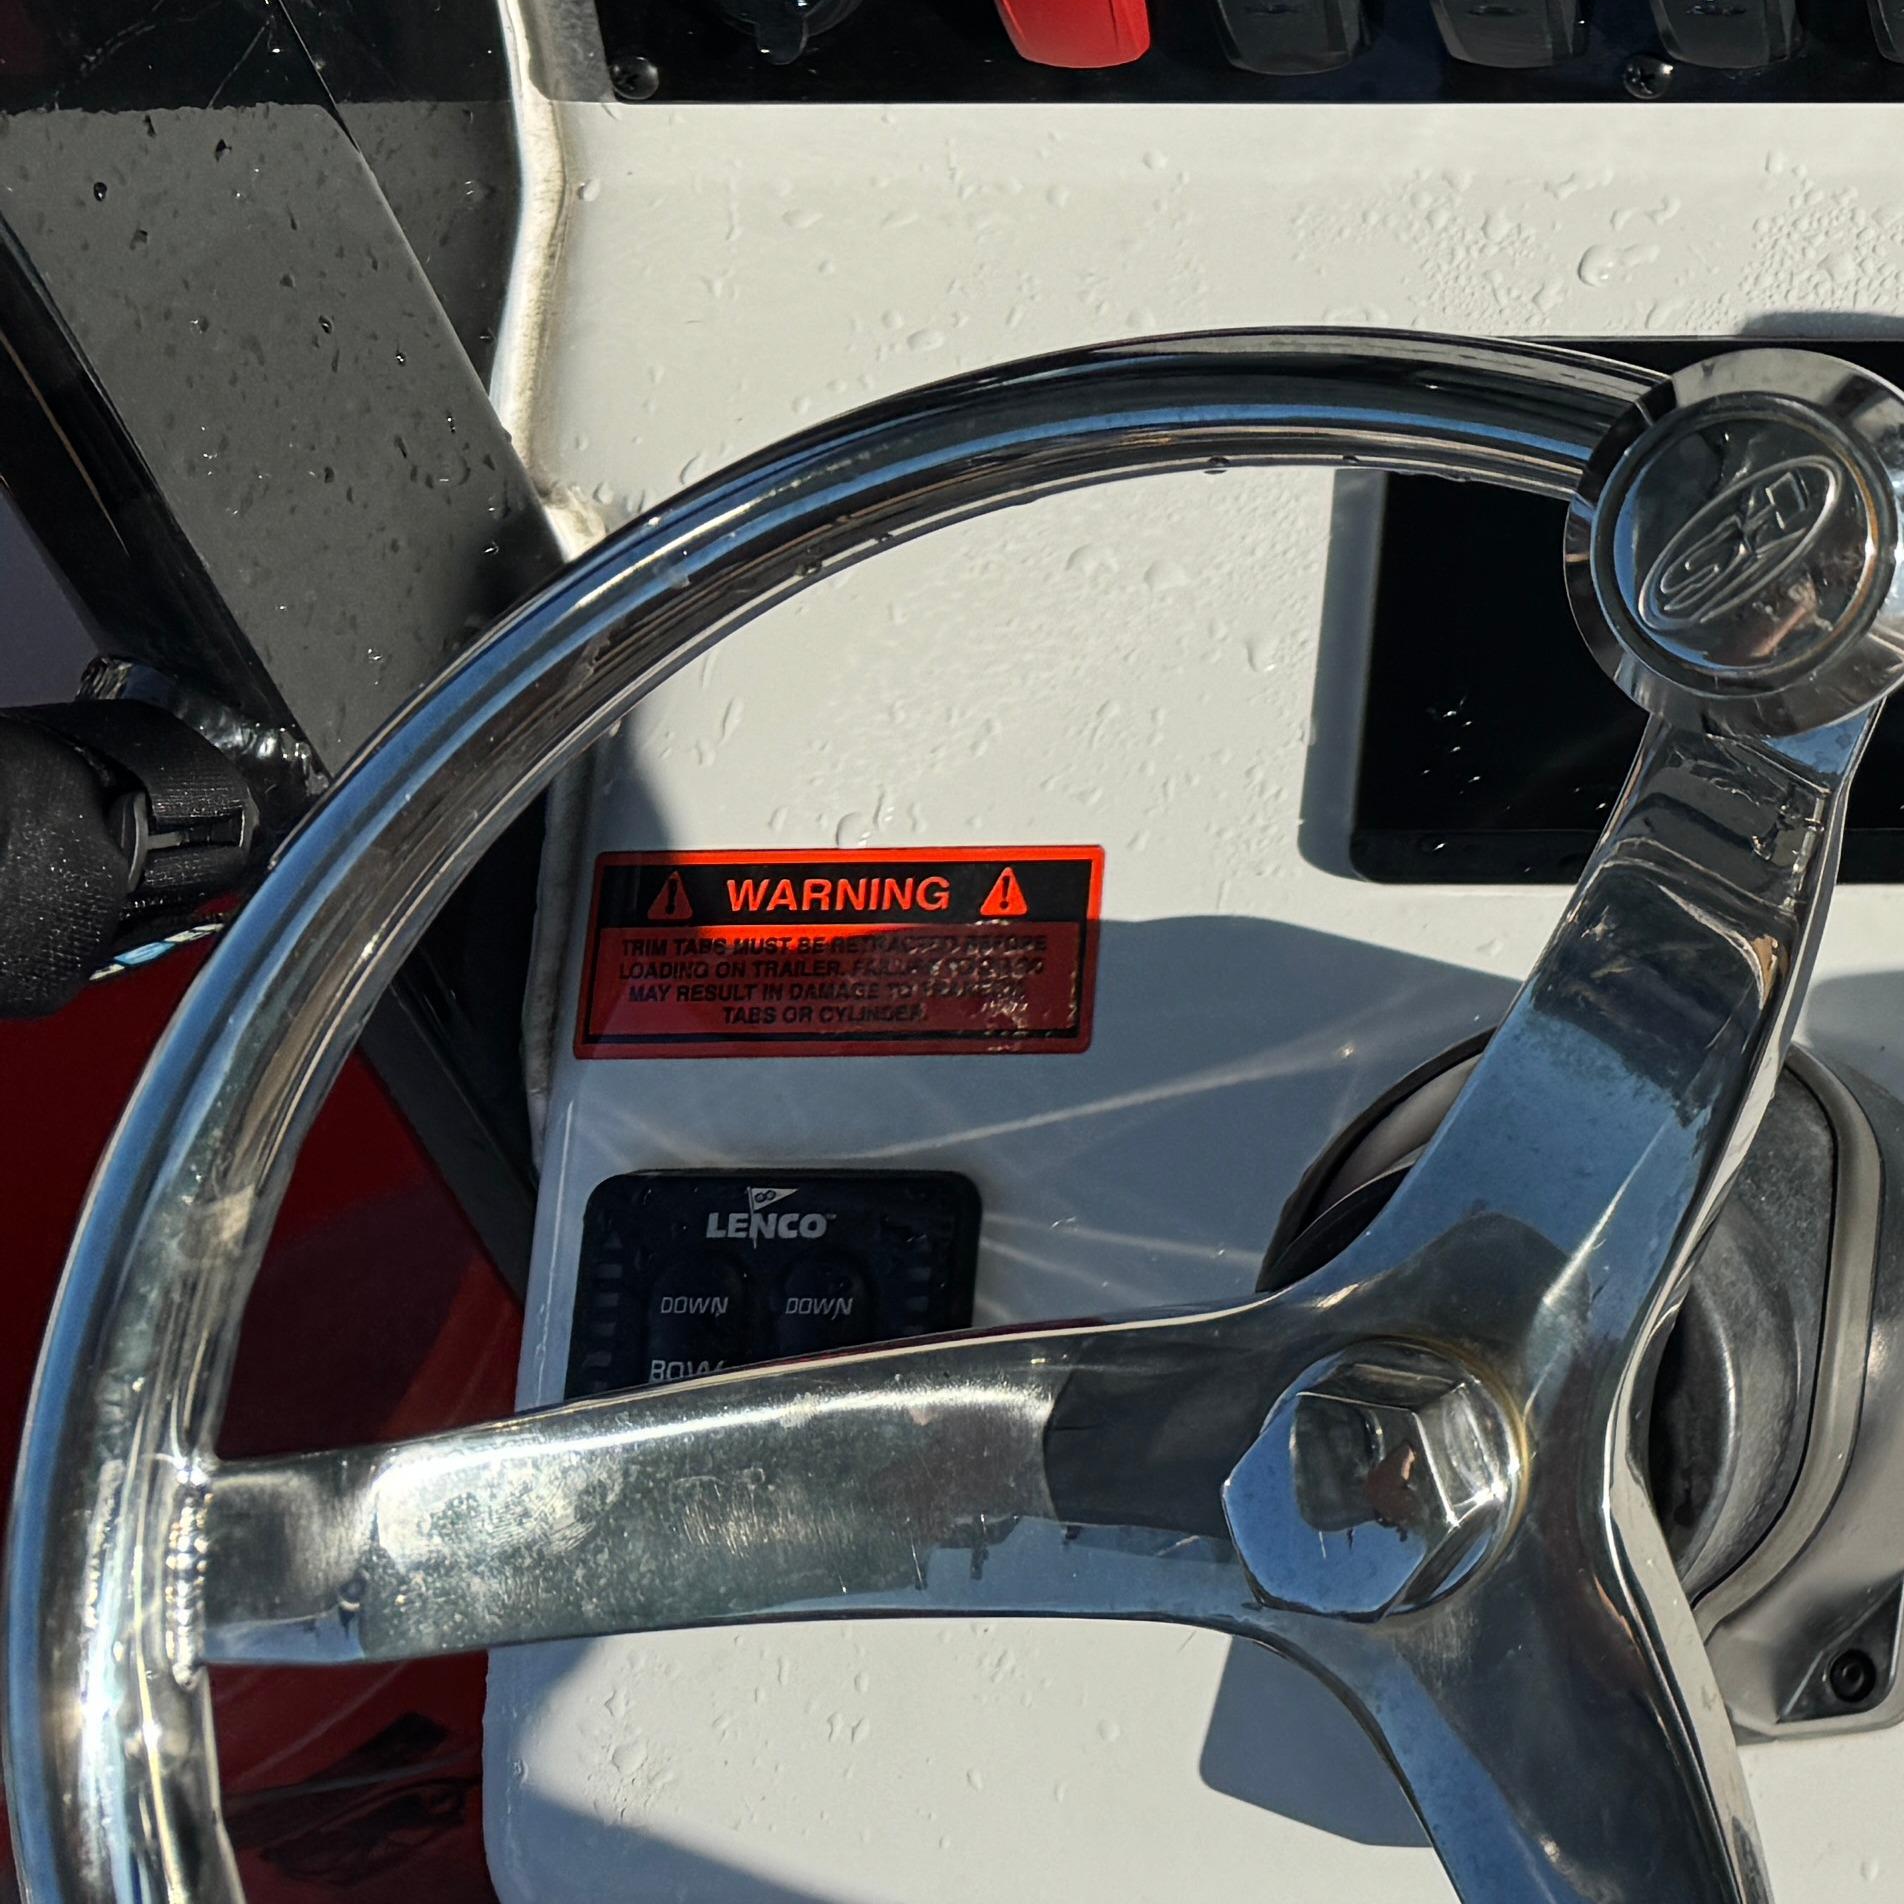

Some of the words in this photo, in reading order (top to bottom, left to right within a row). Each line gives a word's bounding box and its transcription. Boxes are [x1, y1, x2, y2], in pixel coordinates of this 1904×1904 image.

[727, 875, 951, 912] WARNING
[622, 938, 667, 957] TRIM
[673, 938, 728, 956] TABS
[732, 936, 792, 956] MUST
[619, 961, 709, 980] LOADING
[715, 960, 746, 979] ON
[628, 984, 671, 1002] MAY
[676, 984, 756, 1002] RESULT
[761, 983, 783, 1001] IN
[723, 1007, 776, 1024] TABS
[782, 1006, 813, 1024] OR
[705, 1211, 828, 1239] LENCO
[661, 1296, 728, 1314] DOWN
[785, 1297, 854, 1315] DOWN
